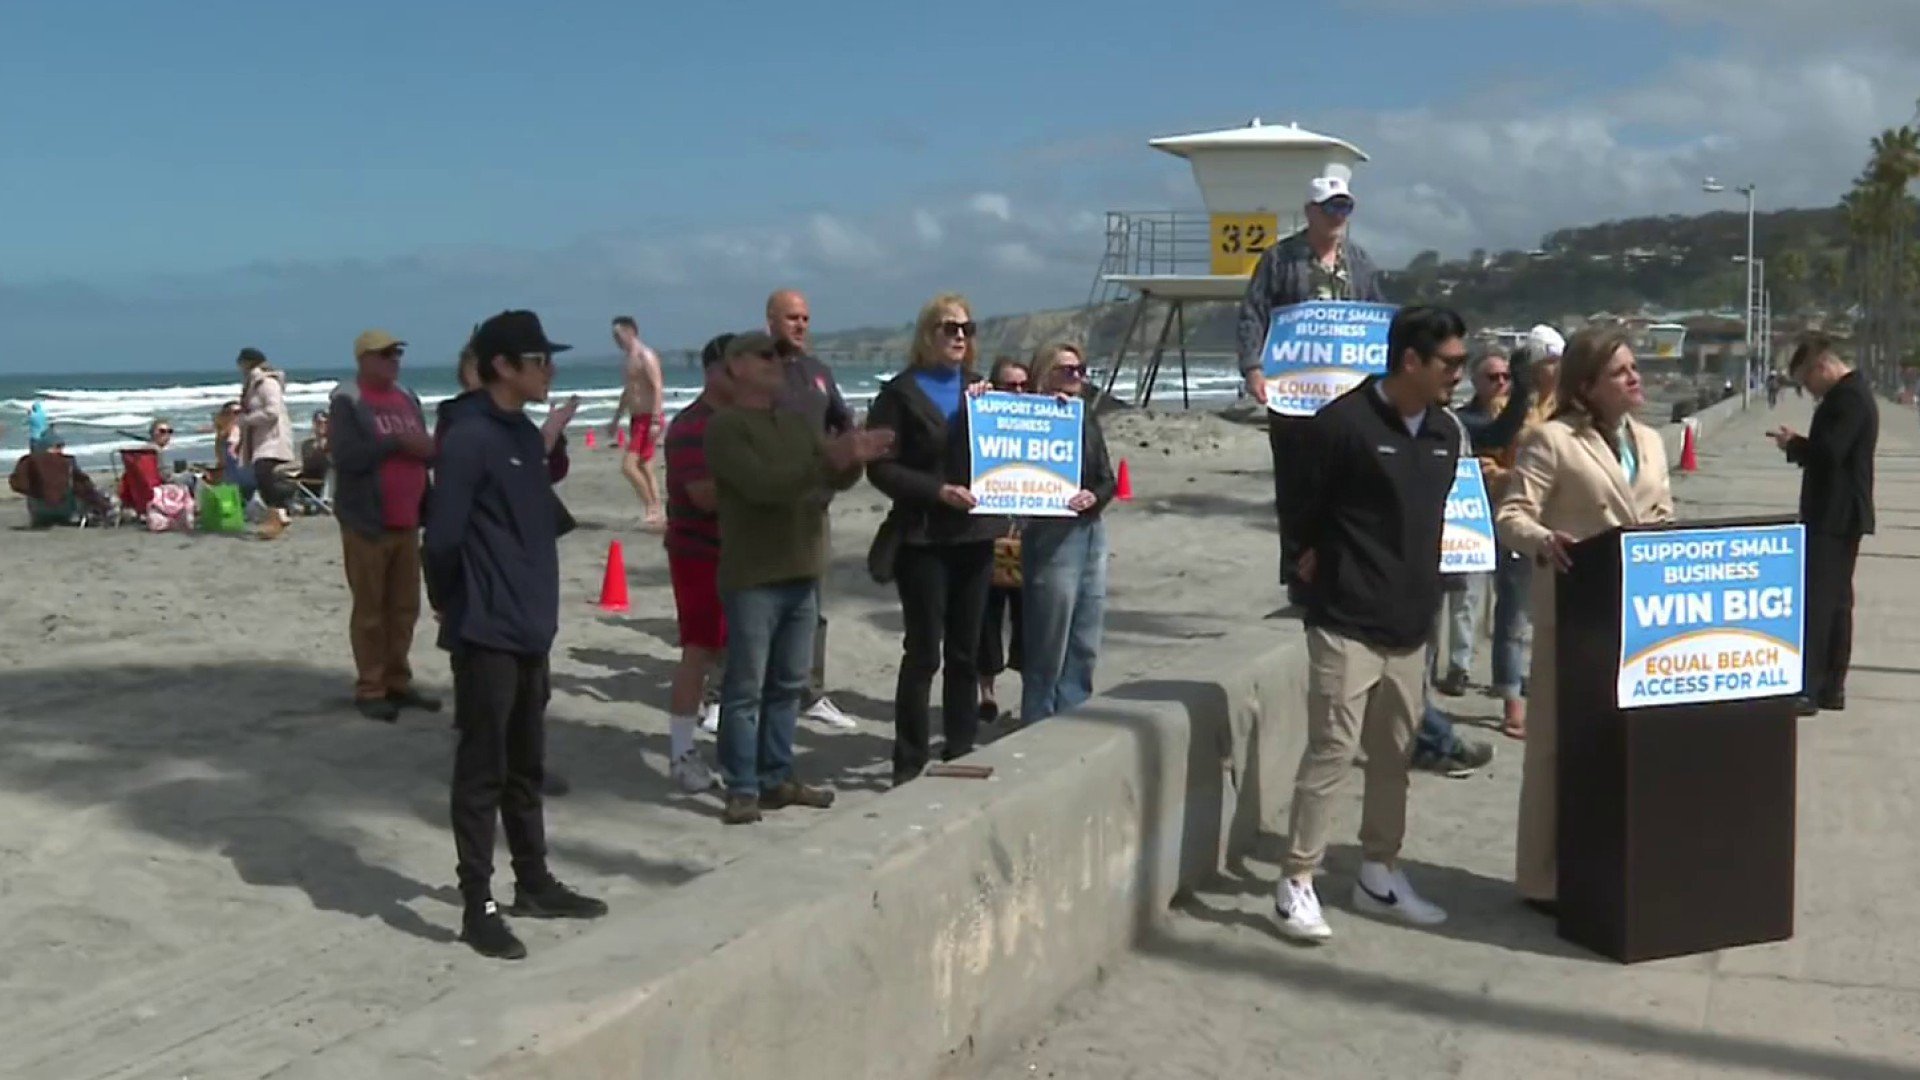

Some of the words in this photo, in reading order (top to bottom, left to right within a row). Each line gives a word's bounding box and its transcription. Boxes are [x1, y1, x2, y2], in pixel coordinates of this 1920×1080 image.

[1222, 224, 1264, 253] 32
[1277, 308, 1345, 325] SUPPORT
[1348, 309, 1389, 322] SMALL
[1295, 322, 1366, 337] BUSINESS
[1271, 340, 1334, 364] WIN
[1278, 381, 1331, 397] EQUAL
[976, 400, 1031, 415] SUPPORT
[1034, 404, 1075, 419] SMALL
[997, 416, 1051, 433] BUSINESS
[978, 435, 1022, 458] WIN
[1027, 438, 1074, 462] BIG!
[984, 480, 1018, 493] EQUAL
[1022, 481, 1062, 494] BEACH
[978, 495, 1017, 508] ACCESS
[1020, 496, 1043, 509] FOR
[1441, 539, 1480, 551] BEACH
[1631, 541, 1725, 563] SUPPORT
[1729, 537, 1793, 558] SMALL
[1466, 552, 1487, 564] ALL
[1664, 562, 1760, 583] BUSINESS
[1632, 591, 1713, 627] WIN
[1723, 586, 1793, 621] BIG!
[1645, 653, 1712, 676] EQUAL
[1717, 648, 1779, 669] BEACH
[1632, 676, 1709, 697] ACCESS
[1714, 672, 1752, 691] FOR
[1756, 668, 1789, 686] ALL
